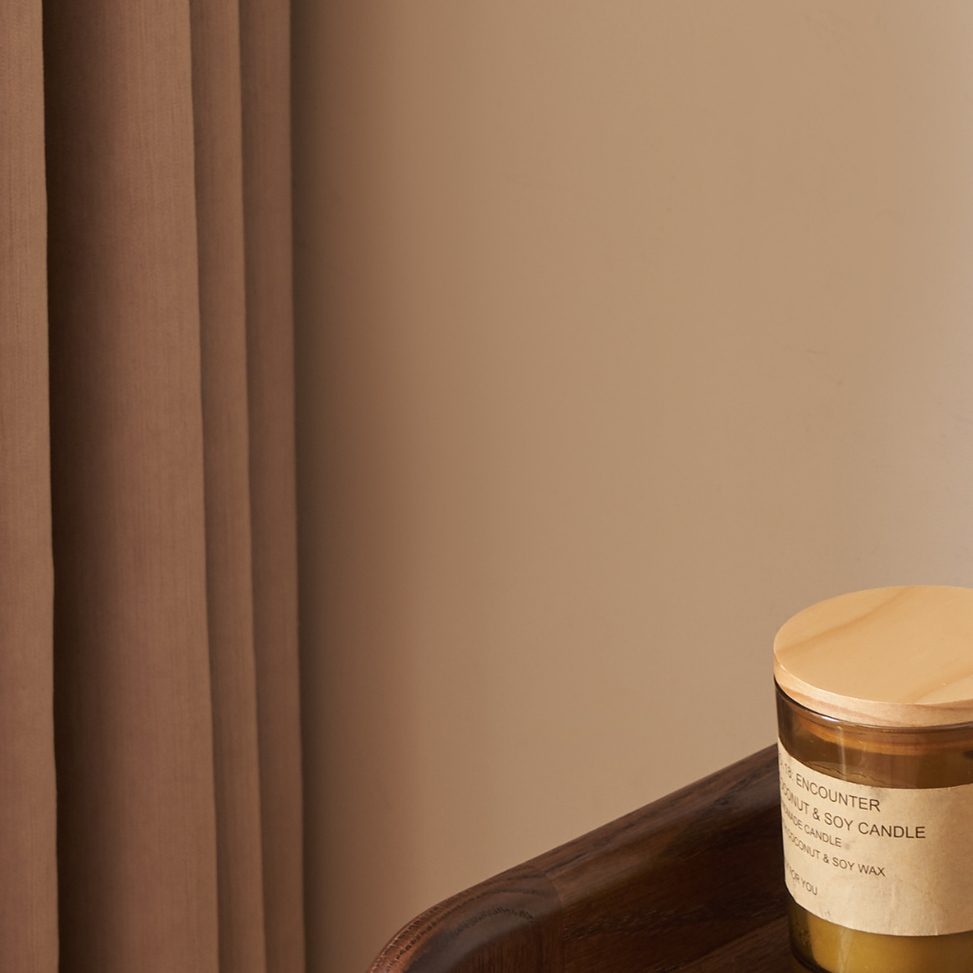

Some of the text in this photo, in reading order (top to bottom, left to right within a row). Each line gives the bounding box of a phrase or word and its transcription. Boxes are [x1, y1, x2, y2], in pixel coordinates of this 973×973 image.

[796, 772, 881, 812] ENCOUNTER
[812, 807, 821, 821] &
[824, 812, 854, 831] SOY
[858, 821, 926, 839] CANDLE
[804, 824, 842, 848] CANDLE
[823, 853, 830, 865] &
[832, 856, 855, 871] SOY
[857, 863, 886, 877] WAX
[801, 877, 818, 896] YOU
